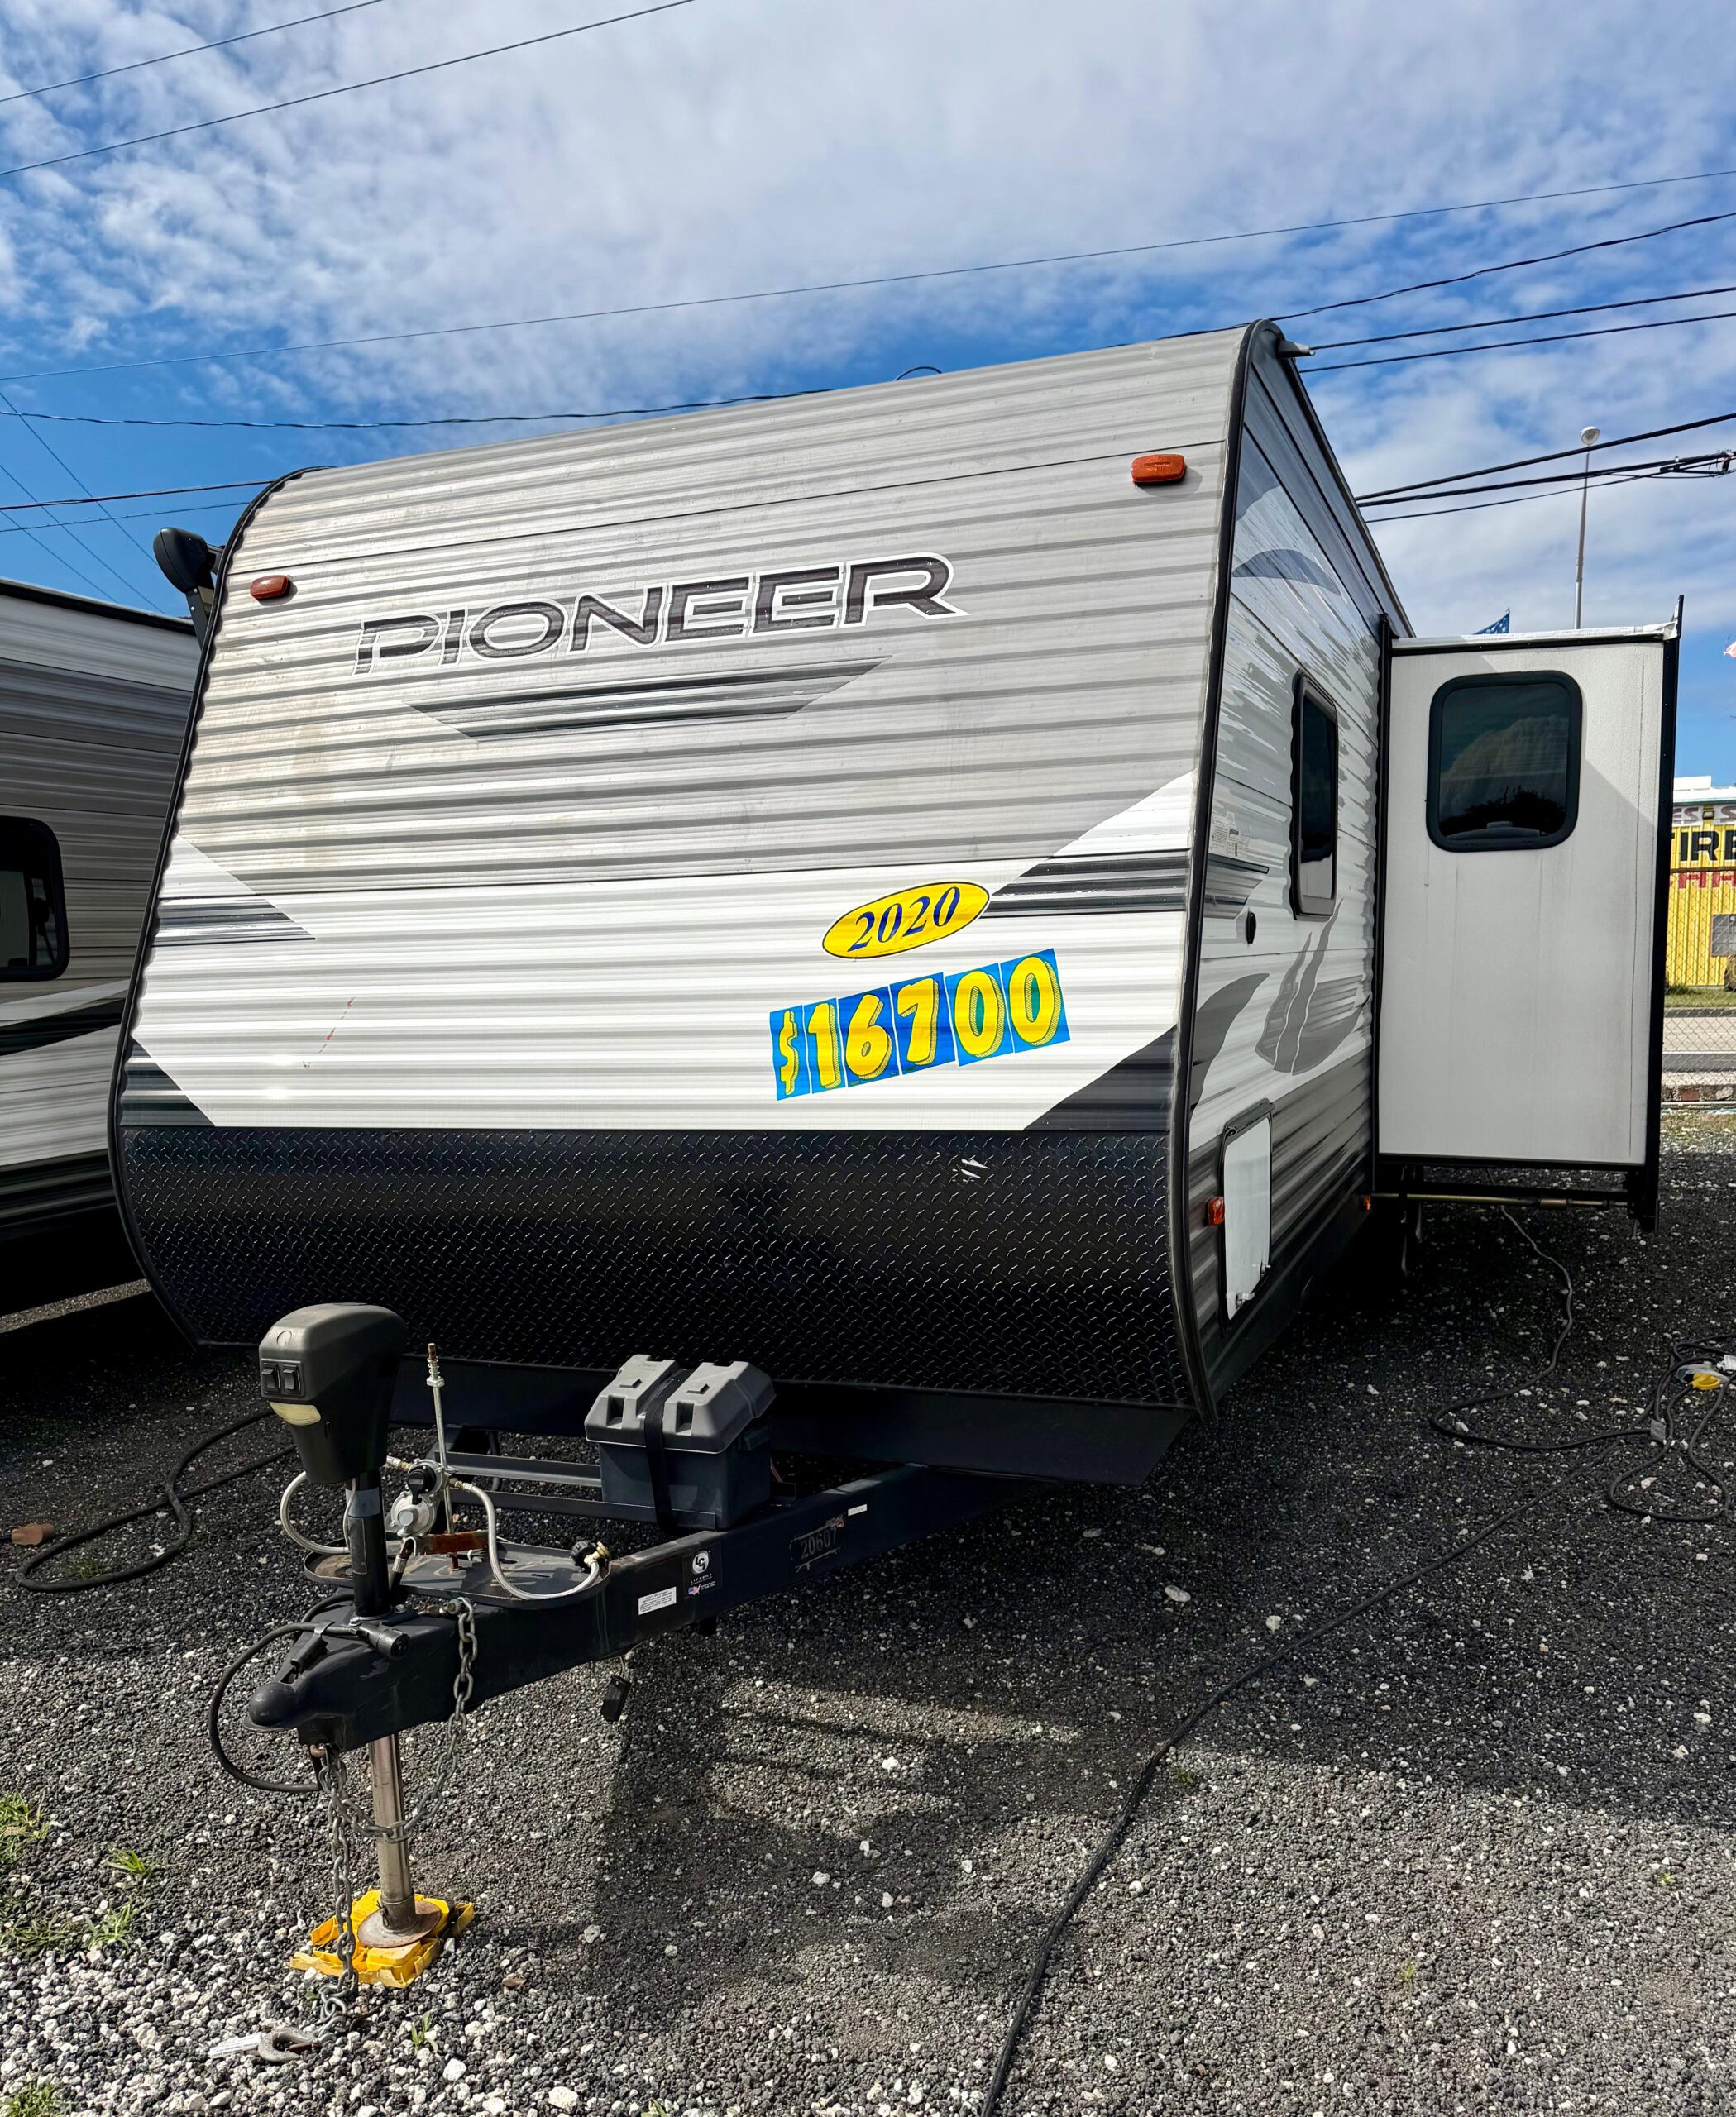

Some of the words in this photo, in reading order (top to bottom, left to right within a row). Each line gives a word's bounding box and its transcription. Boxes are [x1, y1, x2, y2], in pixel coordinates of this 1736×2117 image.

[352, 553, 966, 675] PIONEER
[847, 886, 960, 952] 2020
[779, 956, 1061, 1096] $16700
